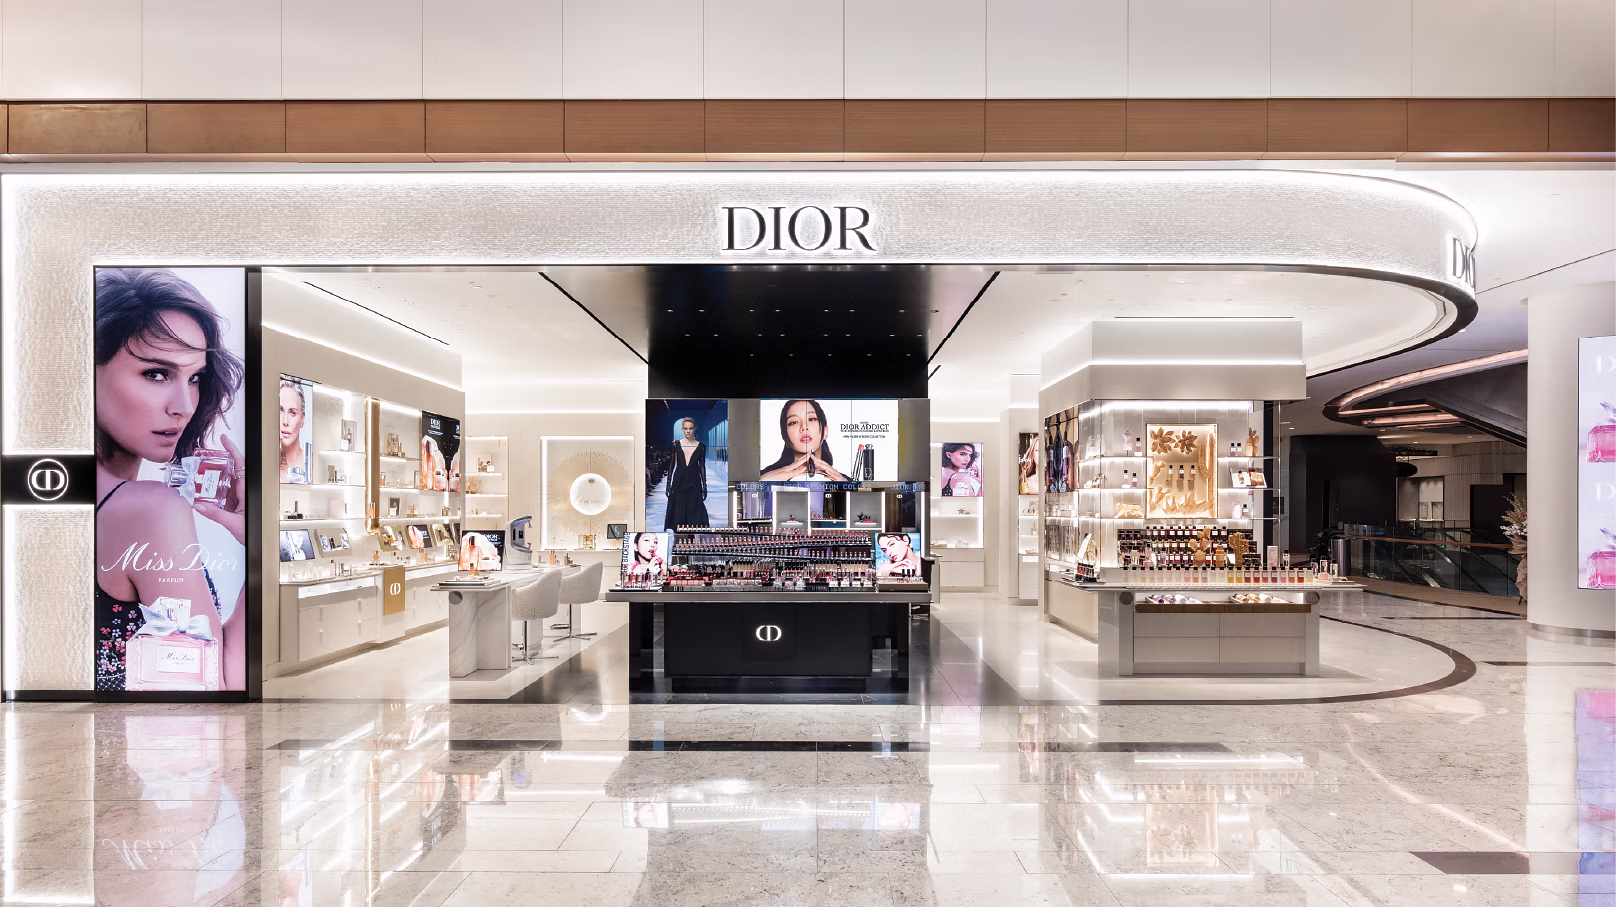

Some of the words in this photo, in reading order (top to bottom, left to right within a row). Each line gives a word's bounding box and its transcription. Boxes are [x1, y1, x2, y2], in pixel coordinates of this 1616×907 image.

[721, 205, 877, 251] DIOR
[101, 542, 174, 572] Miss
[179, 543, 239, 571] Dior
